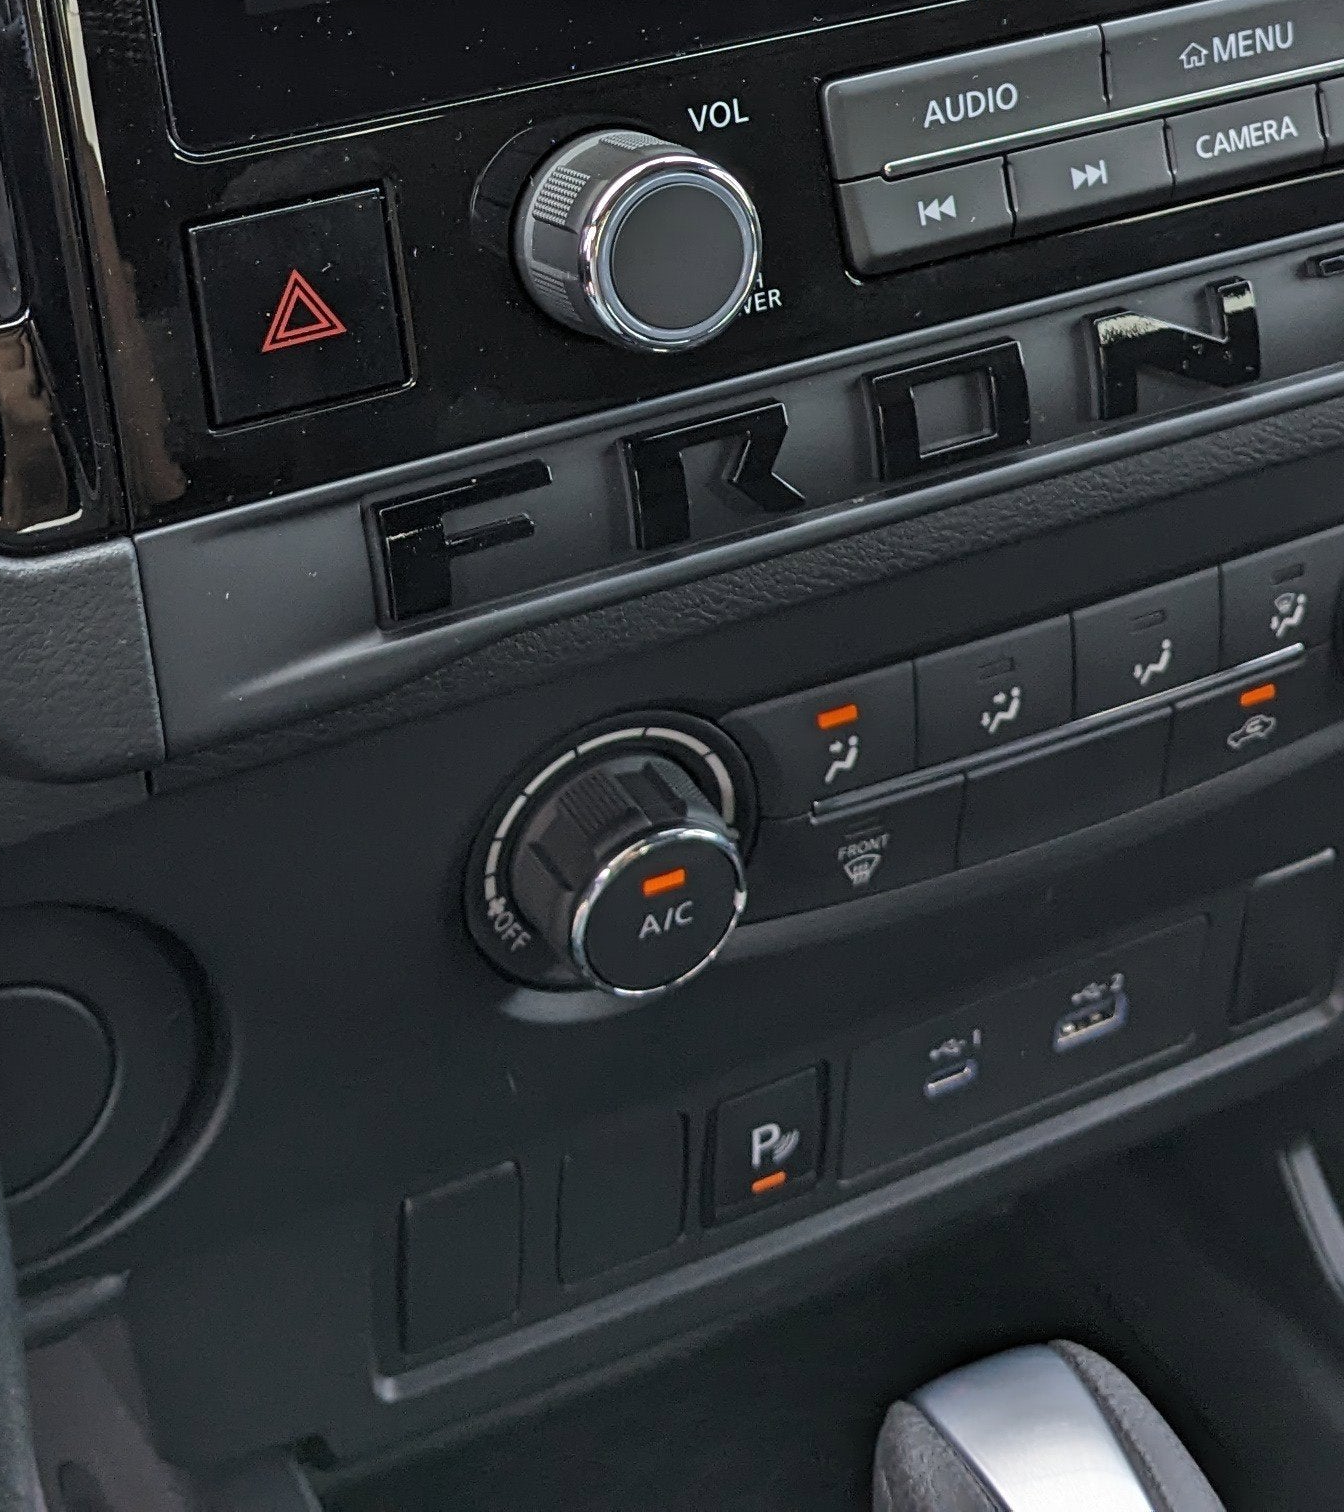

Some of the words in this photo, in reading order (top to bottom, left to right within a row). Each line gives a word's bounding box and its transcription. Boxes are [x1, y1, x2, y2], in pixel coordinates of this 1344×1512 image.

[1211, 21, 1296, 65] MENU
[687, 98, 750, 132] VOL
[922, 82, 1020, 129] AUDIO
[1194, 115, 1299, 160] CAMERA
[838, 834, 890, 861] FRONT
[494, 910, 532, 952] OFF
[638, 900, 695, 939] A/C
